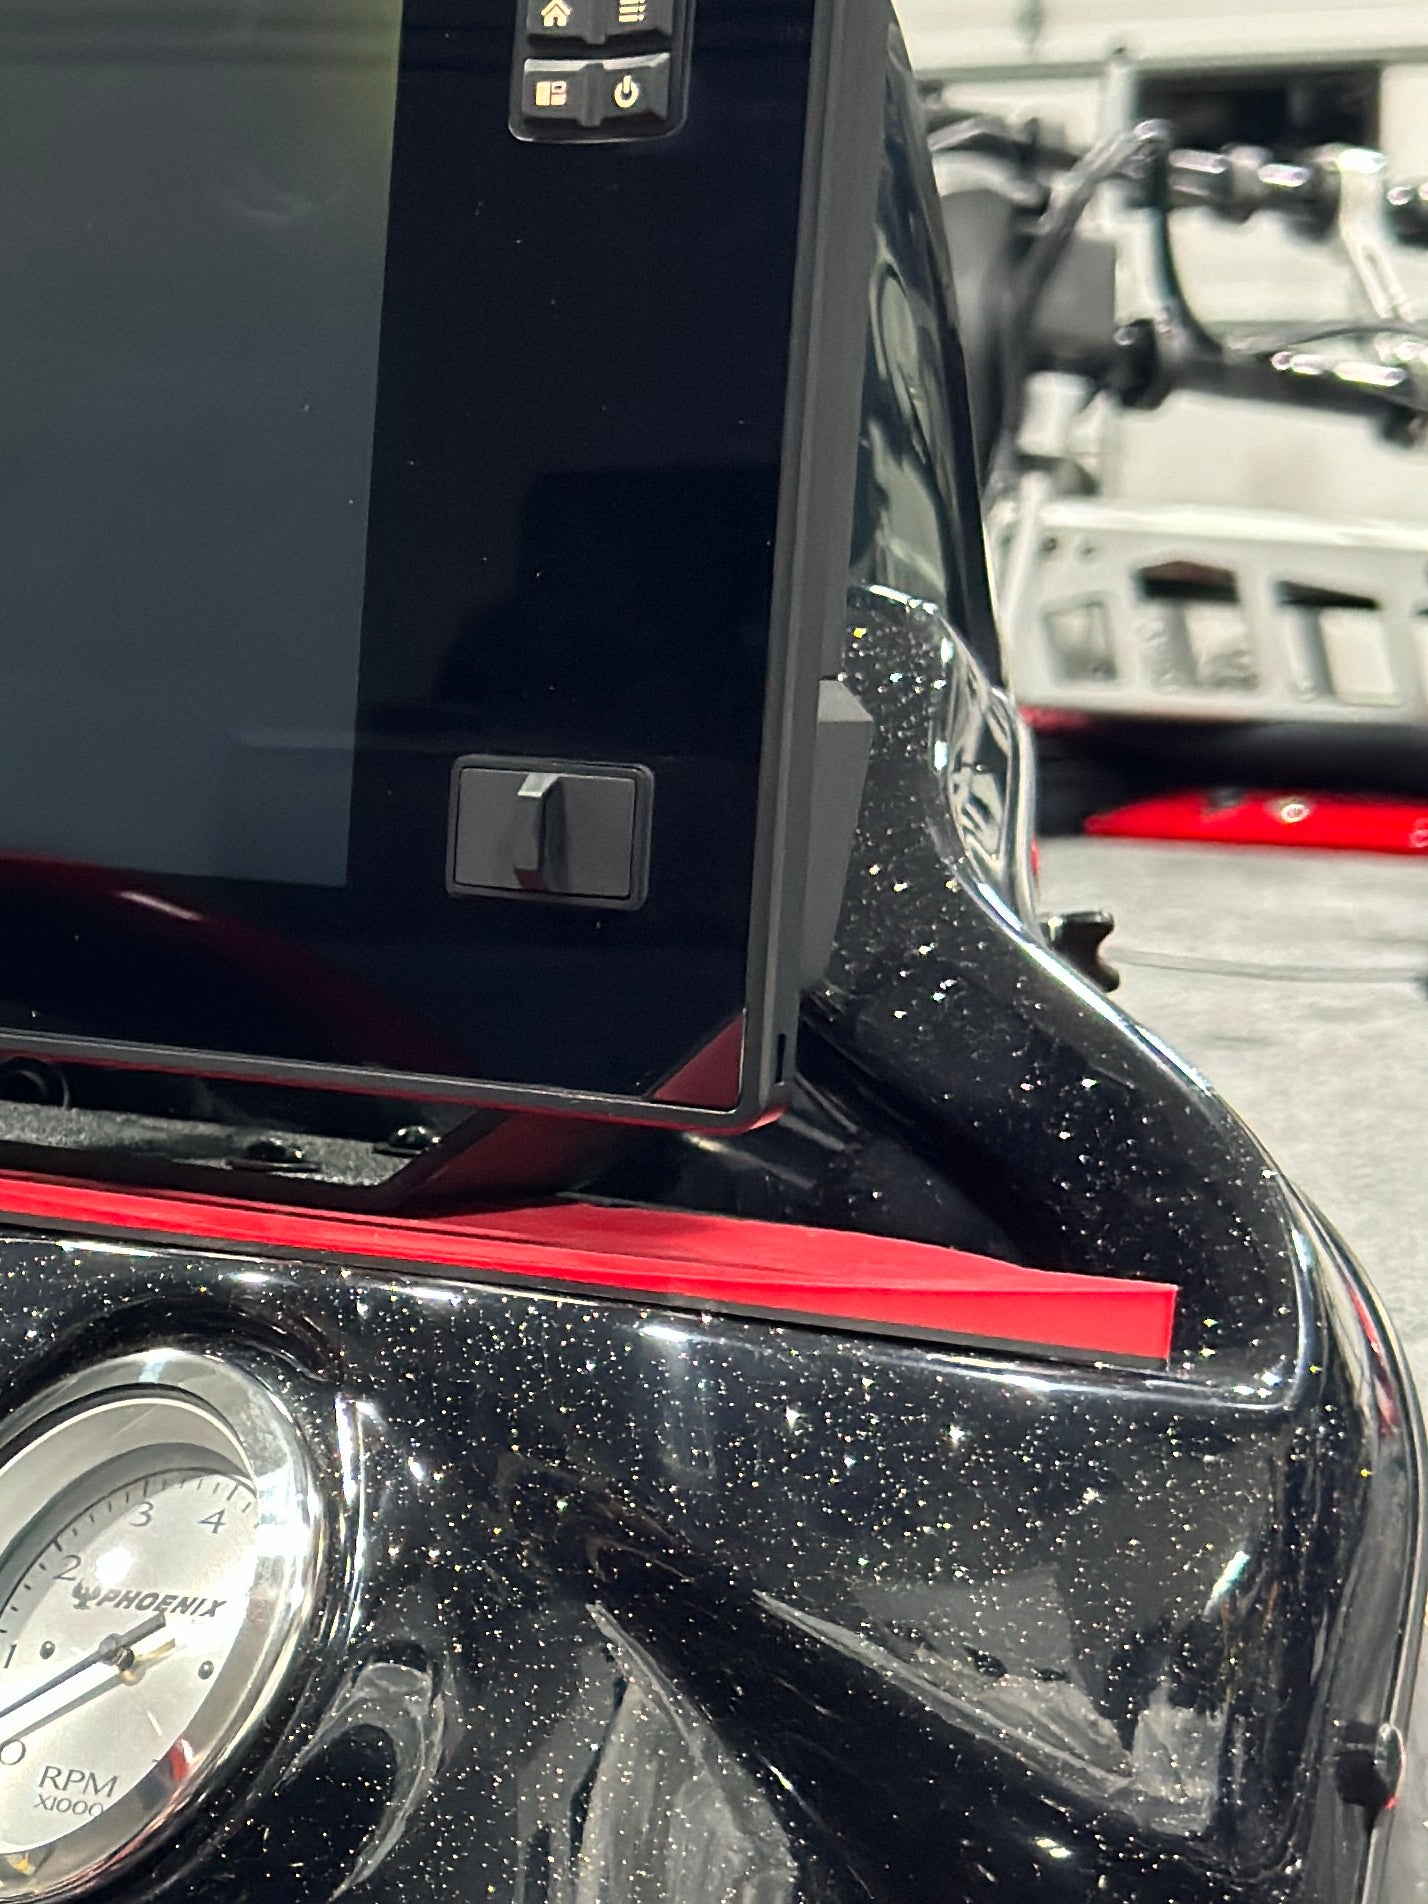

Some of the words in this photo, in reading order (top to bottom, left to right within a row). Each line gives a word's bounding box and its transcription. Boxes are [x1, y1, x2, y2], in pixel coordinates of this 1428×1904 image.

[129, 1501, 154, 1528] 3
[199, 1509, 226, 1534] 4
[52, 1554, 82, 1582] 2
[96, 1587, 227, 1619] PHOENIX
[4, 1643, 18, 1669] 1
[38, 1765, 119, 1798] RPM
